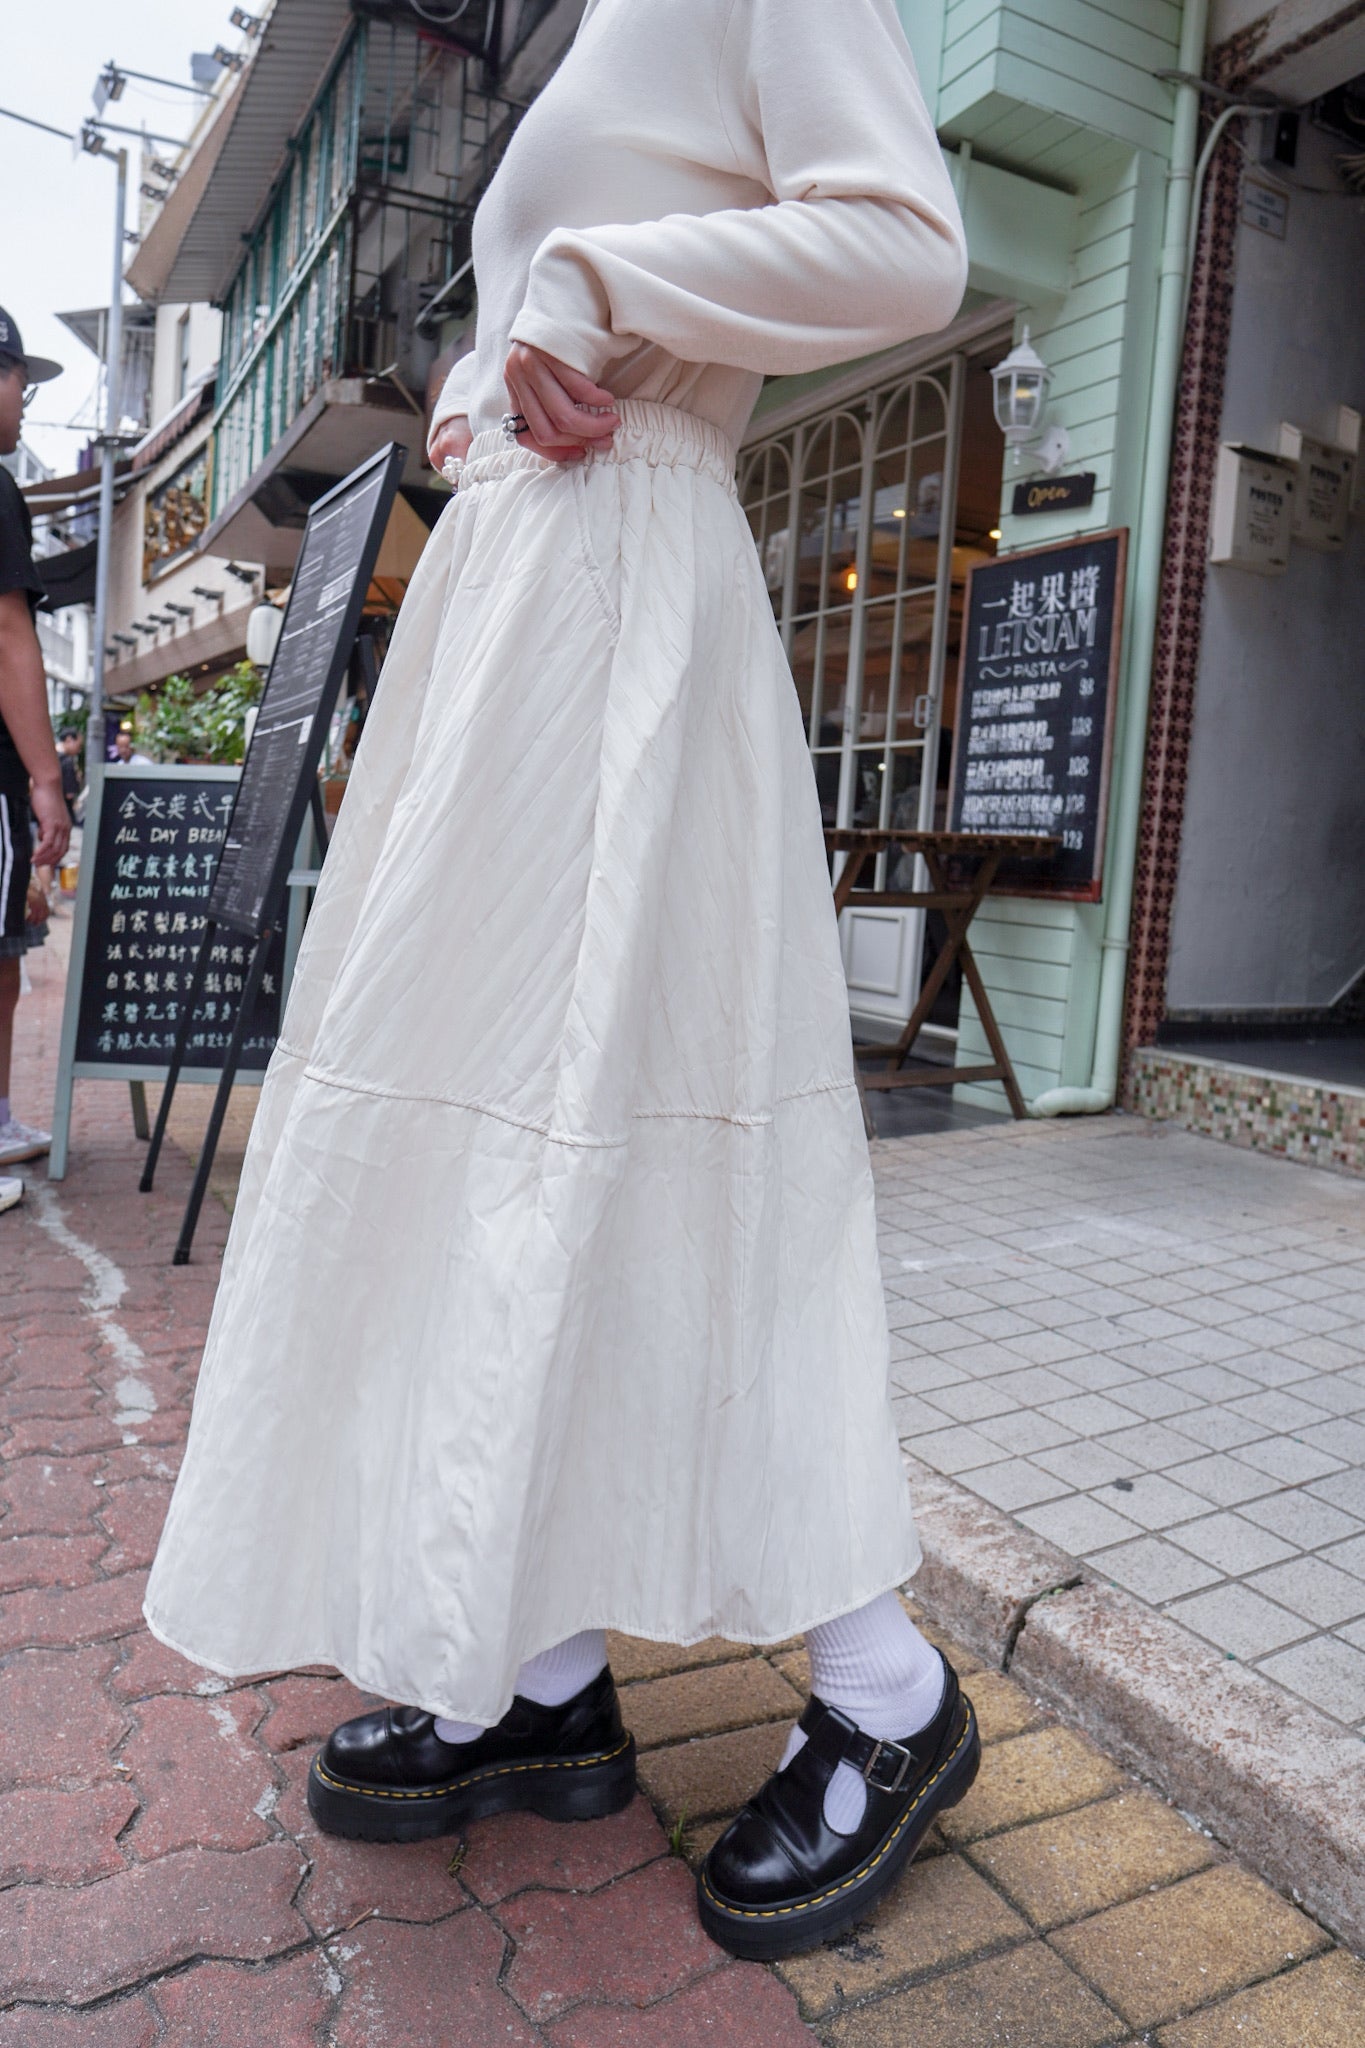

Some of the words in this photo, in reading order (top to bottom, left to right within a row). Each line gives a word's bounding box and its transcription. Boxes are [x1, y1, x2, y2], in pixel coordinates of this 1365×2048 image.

[1027, 486, 1070, 508] Open
[981, 566, 1100, 618] 一起果醬
[1012, 660, 1057, 679] PASTA
[116, 827, 140, 844] ALL
[149, 827, 179, 845] DAY
[110, 884, 135, 900] ALL
[136, 885, 161, 899] DAY
